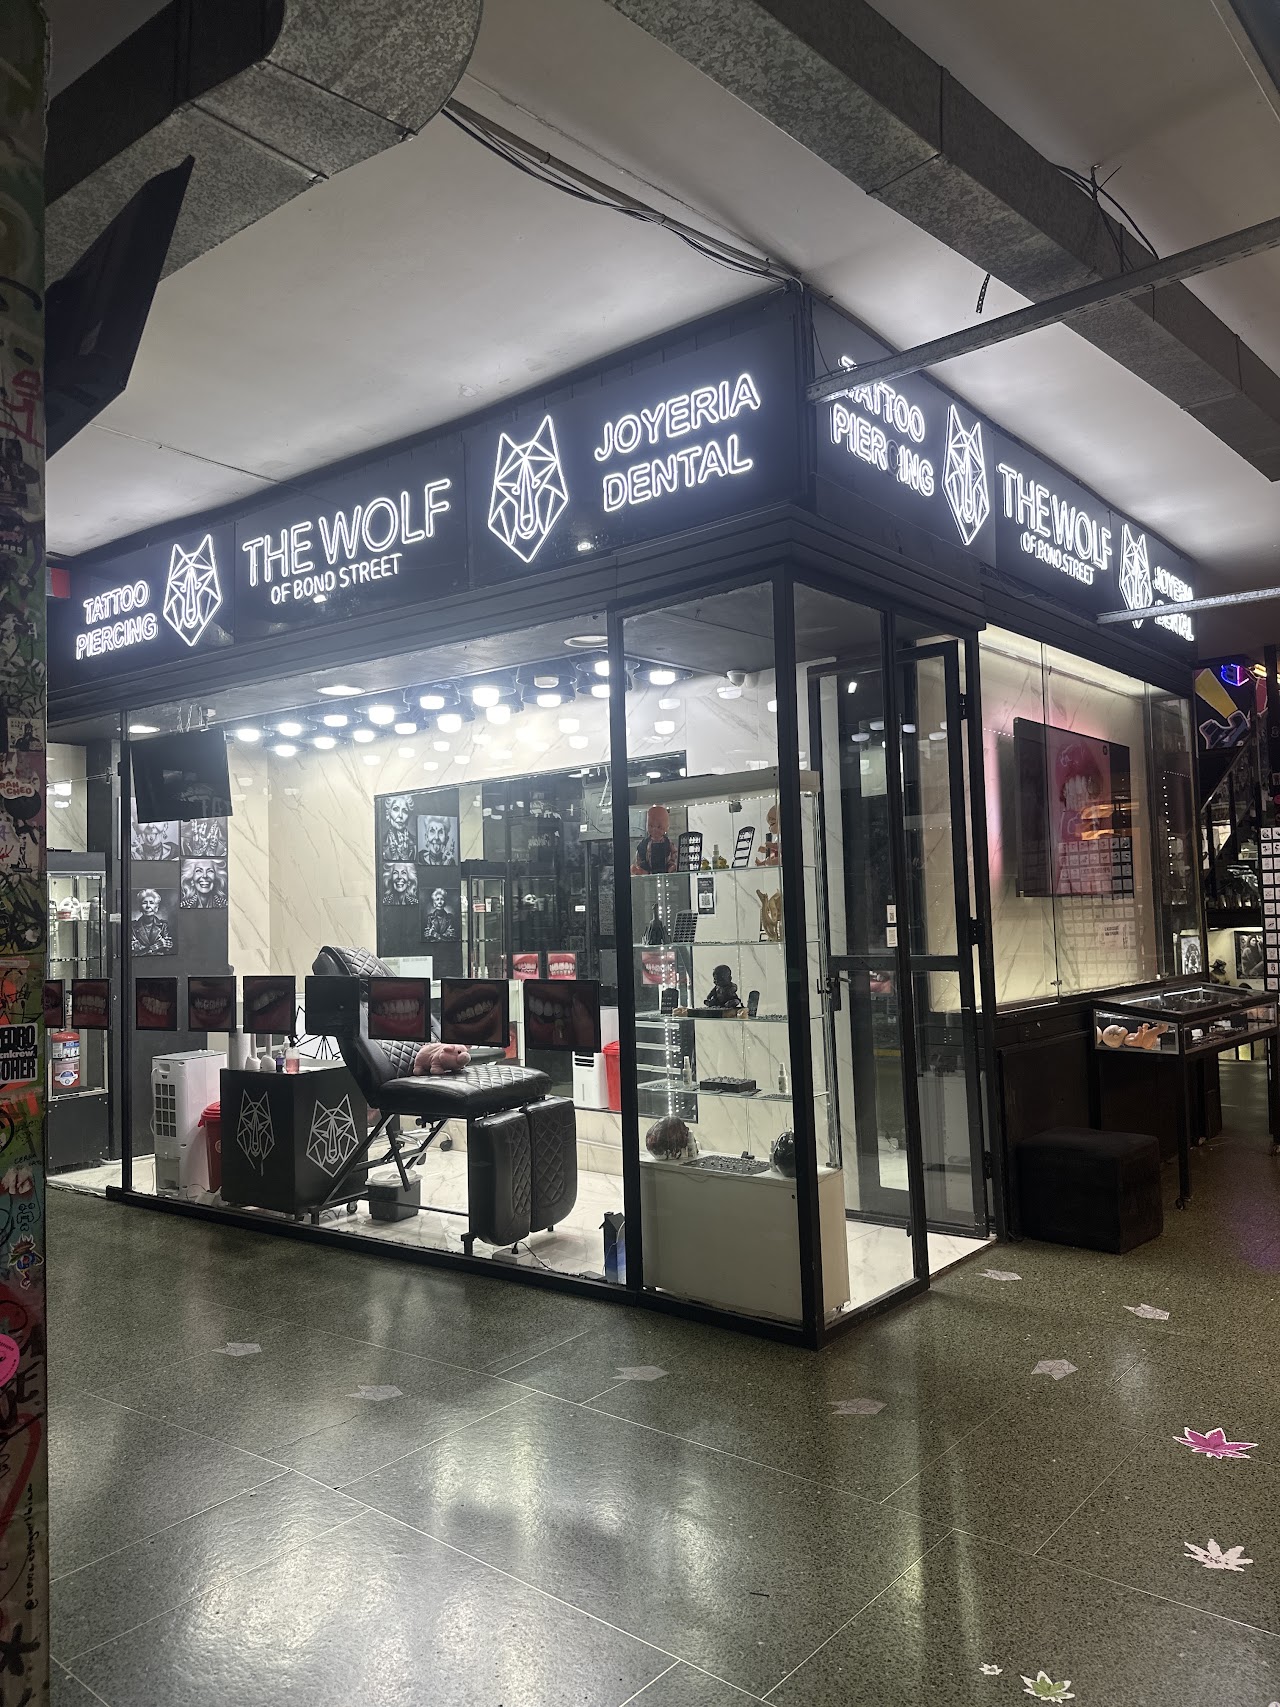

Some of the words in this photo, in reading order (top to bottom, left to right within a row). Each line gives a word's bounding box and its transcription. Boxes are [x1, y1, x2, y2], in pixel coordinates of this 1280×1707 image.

[594, 372, 761, 462] JOYERIA
[830, 402, 934, 497] PIERCING
[602, 434, 754, 512] DENTAL
[242, 521, 314, 587] THE
[318, 478, 452, 565] WOLF
[996, 462, 1051, 538] THE
[1050, 494, 1112, 570] WOLF
[271, 582, 292, 605] OF
[294, 571, 336, 600] BOND
[339, 553, 402, 588] STREET
[1020, 532, 1037, 553] OF
[1036, 539, 1062, 568] BOND
[1060, 553, 1095, 586] STREET
[1152, 566, 1193, 602] JOYERIA
[83, 580, 151, 625] TATTOO
[75, 612, 158, 660] PIERCING
